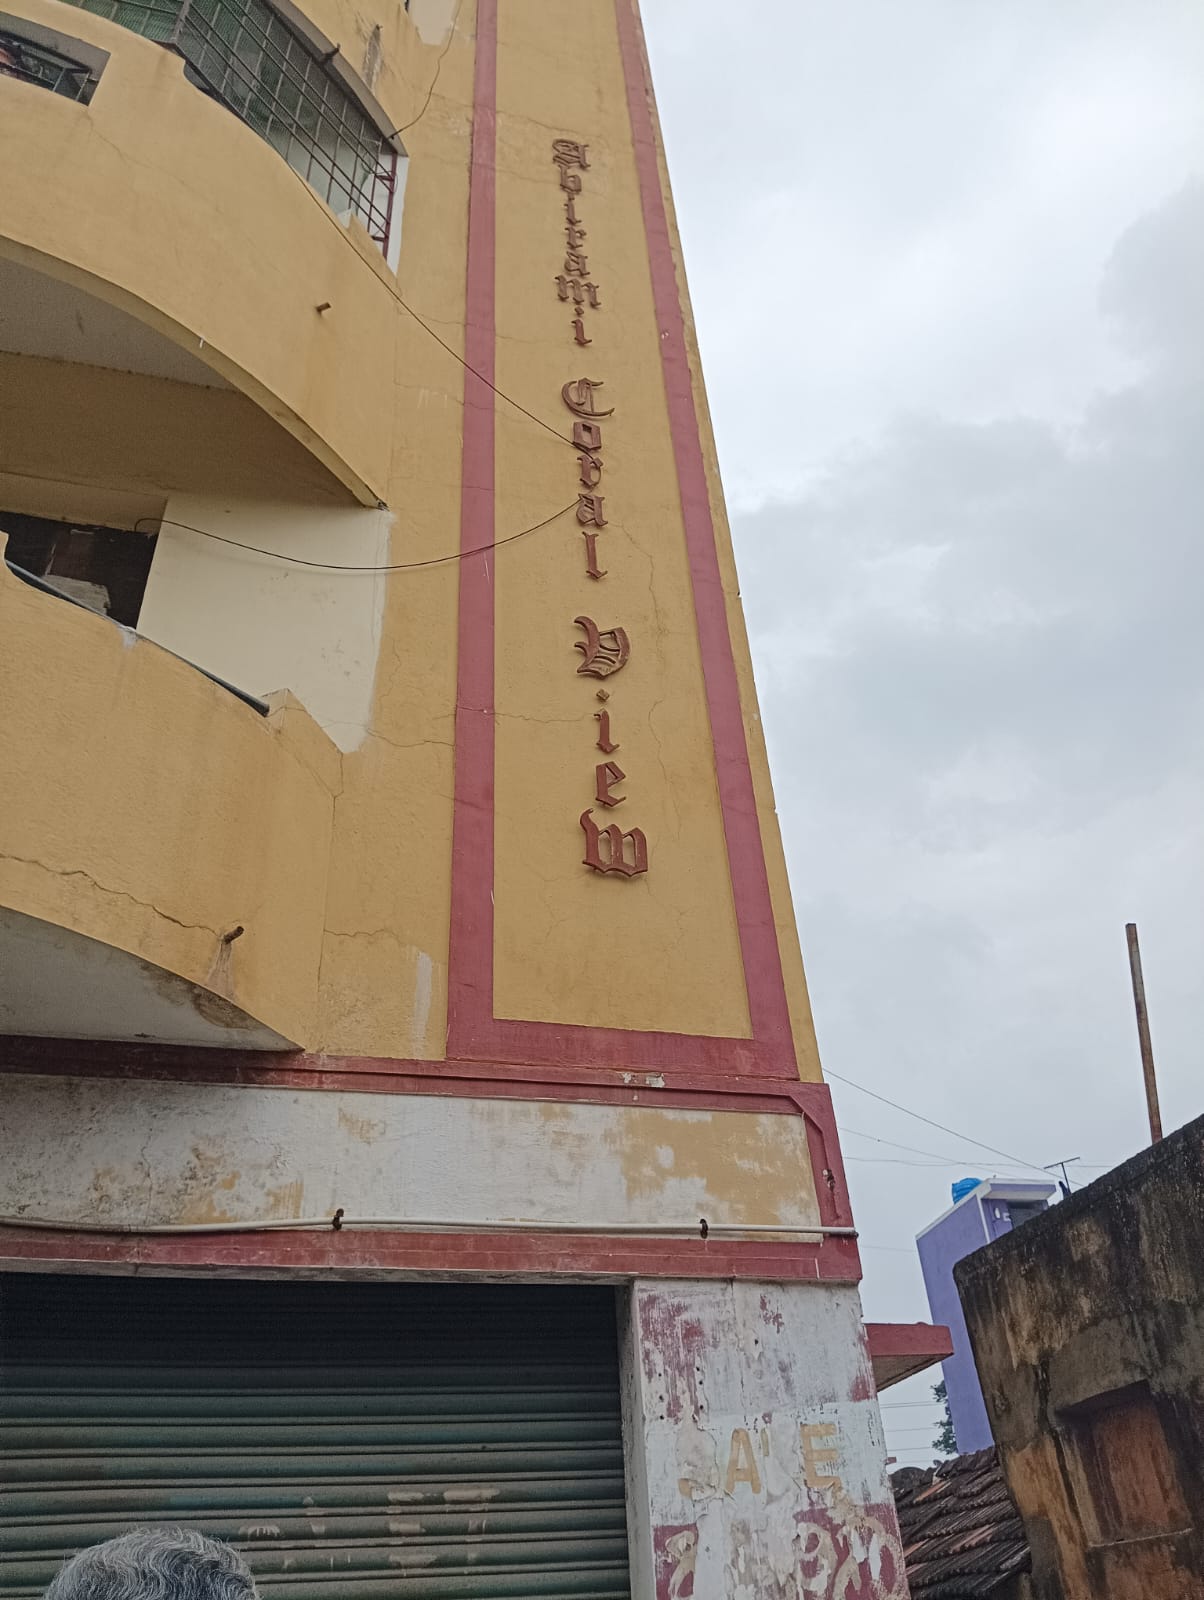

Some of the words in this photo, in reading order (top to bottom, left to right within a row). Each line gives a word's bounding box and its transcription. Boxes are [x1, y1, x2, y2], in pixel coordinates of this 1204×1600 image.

[552, 139, 601, 346] Abirami
[562, 378, 616, 579] Coral
[574, 615, 649, 877] View
